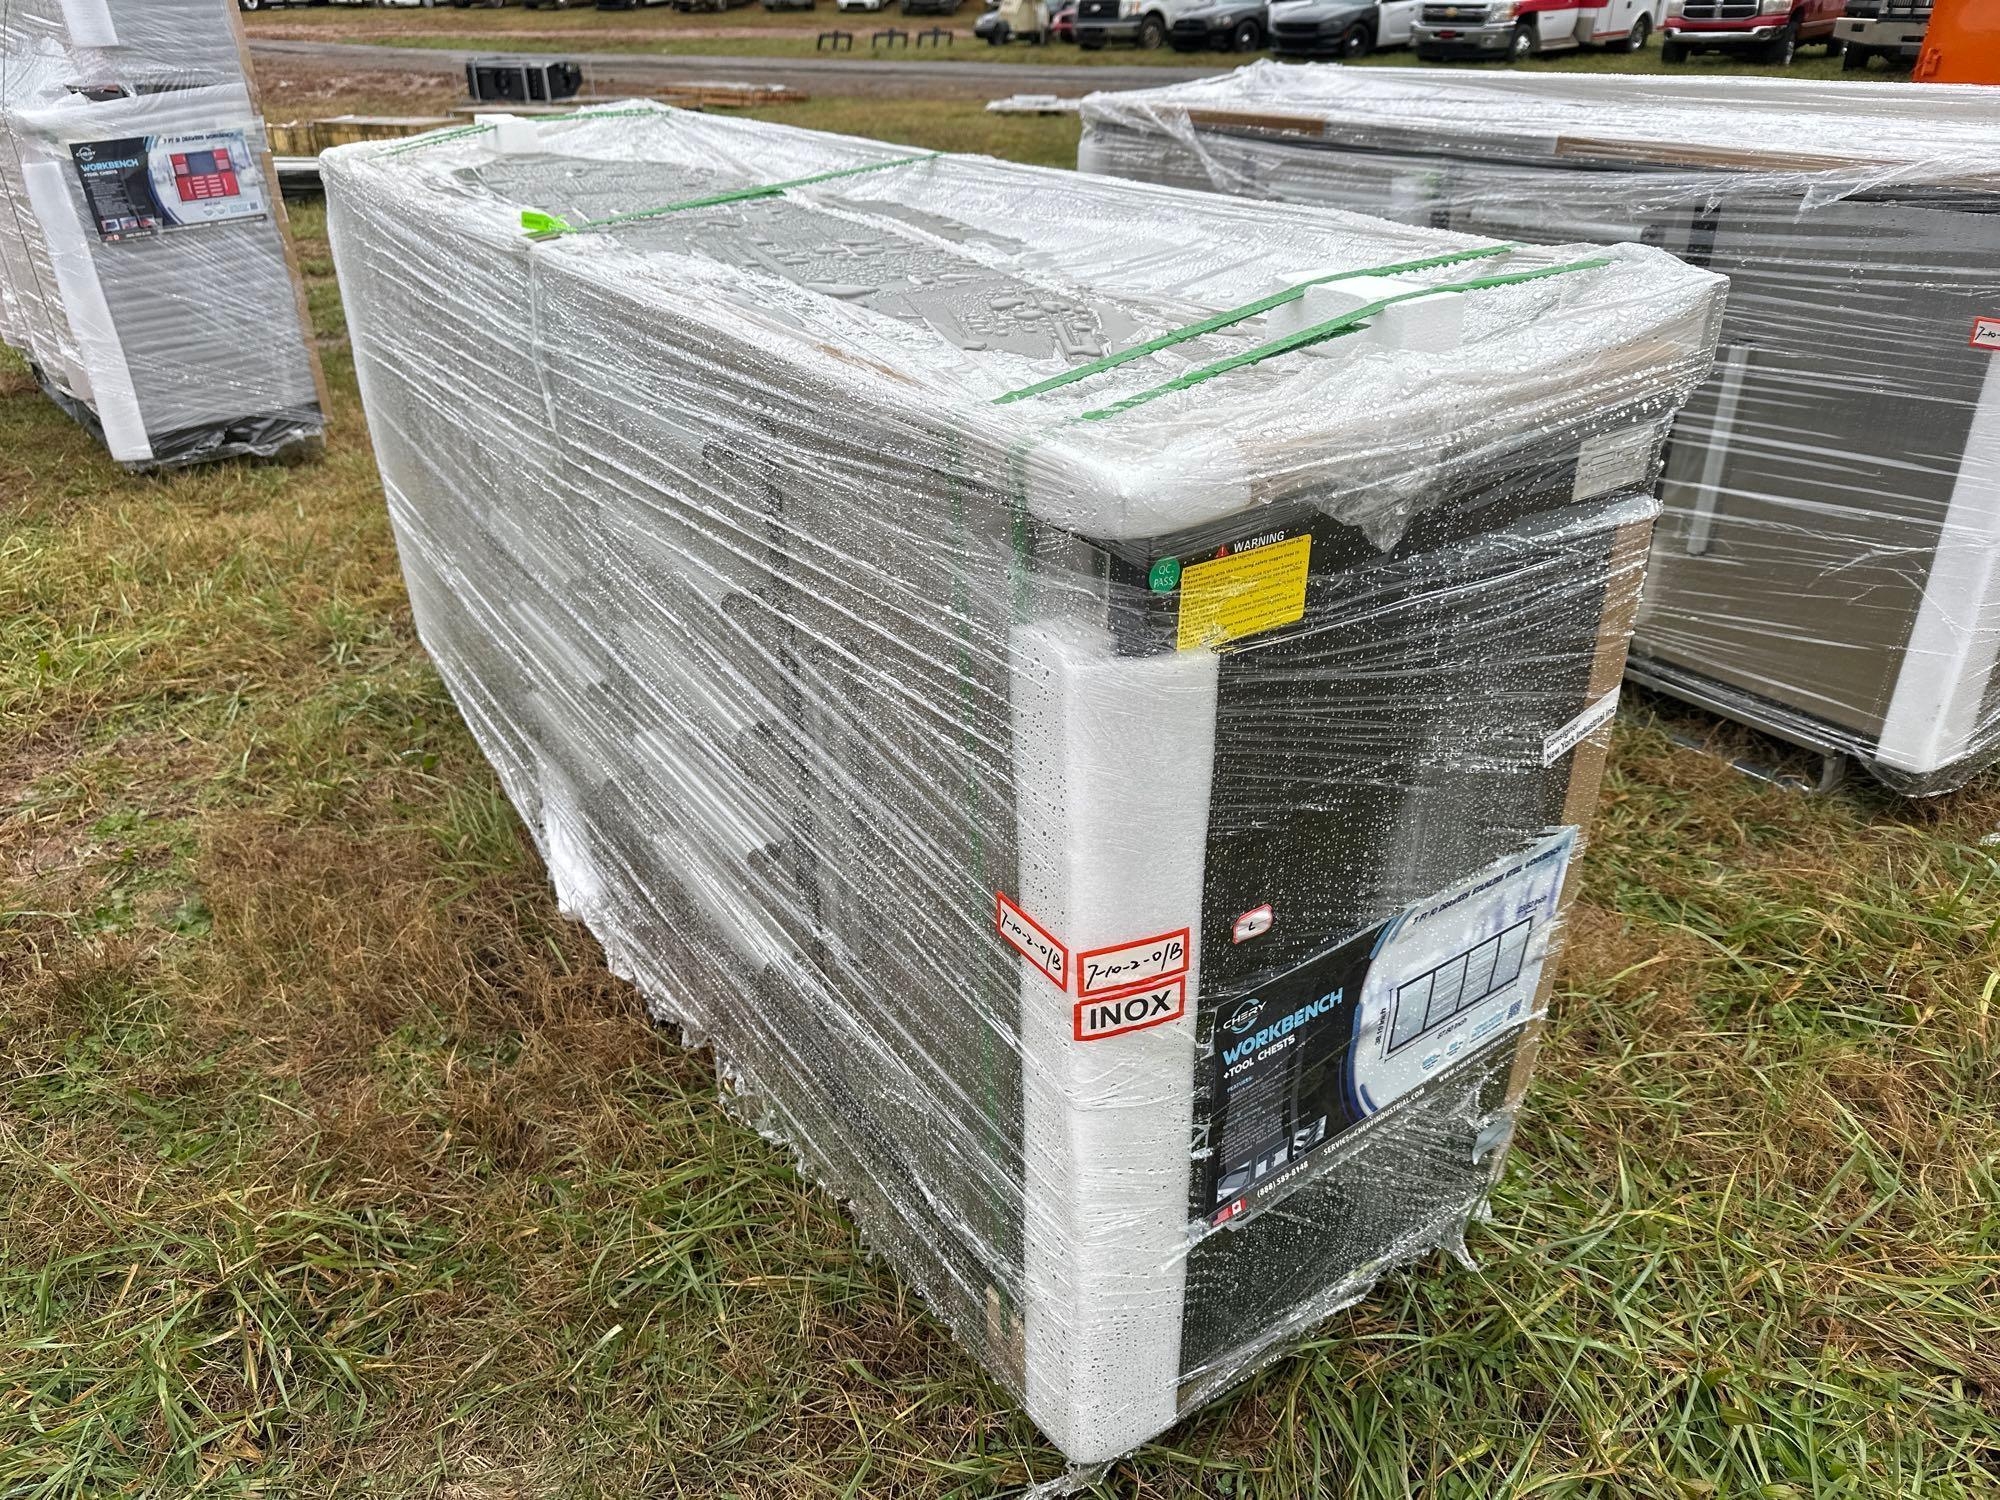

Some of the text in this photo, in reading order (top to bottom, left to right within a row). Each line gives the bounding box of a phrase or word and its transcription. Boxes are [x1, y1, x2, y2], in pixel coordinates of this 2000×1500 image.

[80, 158, 139, 172] WORKBENCH
[1234, 531, 1285, 553] WARNING
[1153, 578, 1174, 588] PASS
[1546, 746, 1560, 761] New
[1561, 735, 1575, 750] York
[1090, 990, 1172, 1030] INOX
[1223, 1001, 1267, 1030] CHERY
[1222, 987, 1343, 1066] WORKBENCH
[1223, 1034, 1295, 1079] +TOOL CHESTS
[1257, 1180, 1276, 1199] (888)
